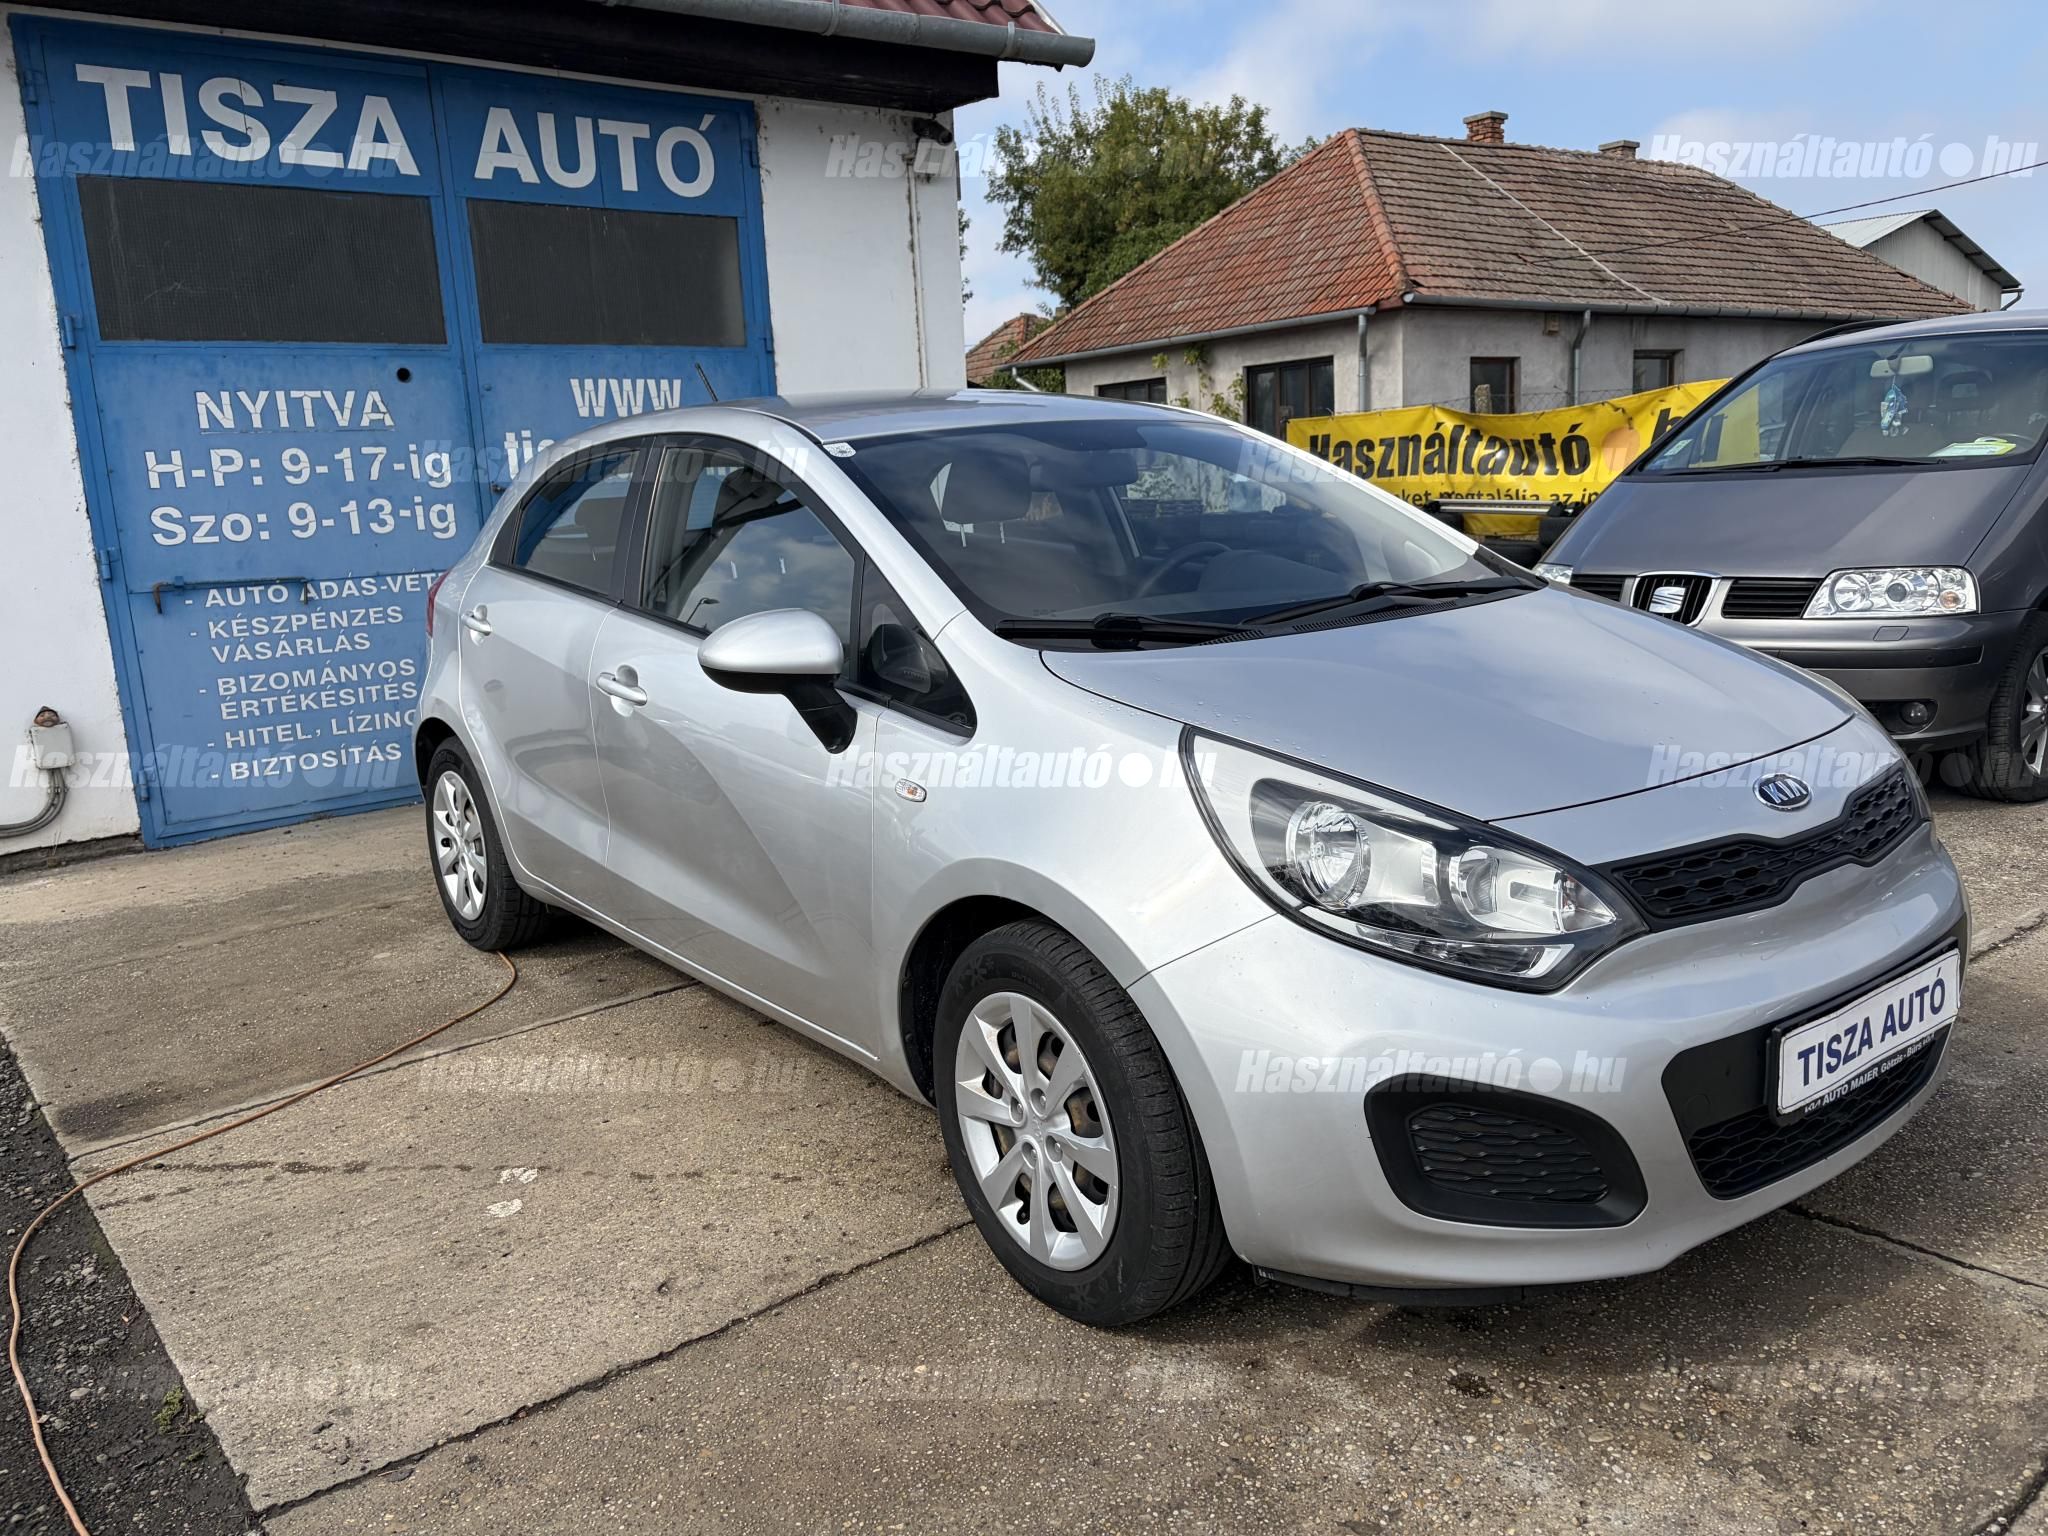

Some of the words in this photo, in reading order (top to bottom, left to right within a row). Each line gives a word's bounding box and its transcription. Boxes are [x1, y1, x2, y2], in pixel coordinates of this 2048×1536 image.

[75, 63, 421, 176] TISZA
[474, 106, 716, 198] AUTÓ
[195, 390, 395, 429] NYITVA
[144, 448, 263, 489] H-P:
[281, 443, 452, 488] 9-17-ig
[150, 506, 270, 547] Szo:
[287, 495, 457, 539] 9-13-ig
[204, 580, 290, 608] AUTÓ
[299, 568, 444, 601] ADÁS-VÉT
[208, 605, 404, 640] KÉSZPÉNZES
[211, 629, 371, 663] VÁSÁRLÁS
[217, 658, 416, 696] BIZOMÁNYOS
[225, 723, 321, 749] HITEL,
[230, 739, 402, 780] BIZTOSÍTÁS
[1797, 1016, 1874, 1087] TISZA
[1879, 967, 1946, 1044] AUTÓ
[1822, 1084, 1849, 1106] AUTO
[1849, 1067, 1879, 1092] MAIER
